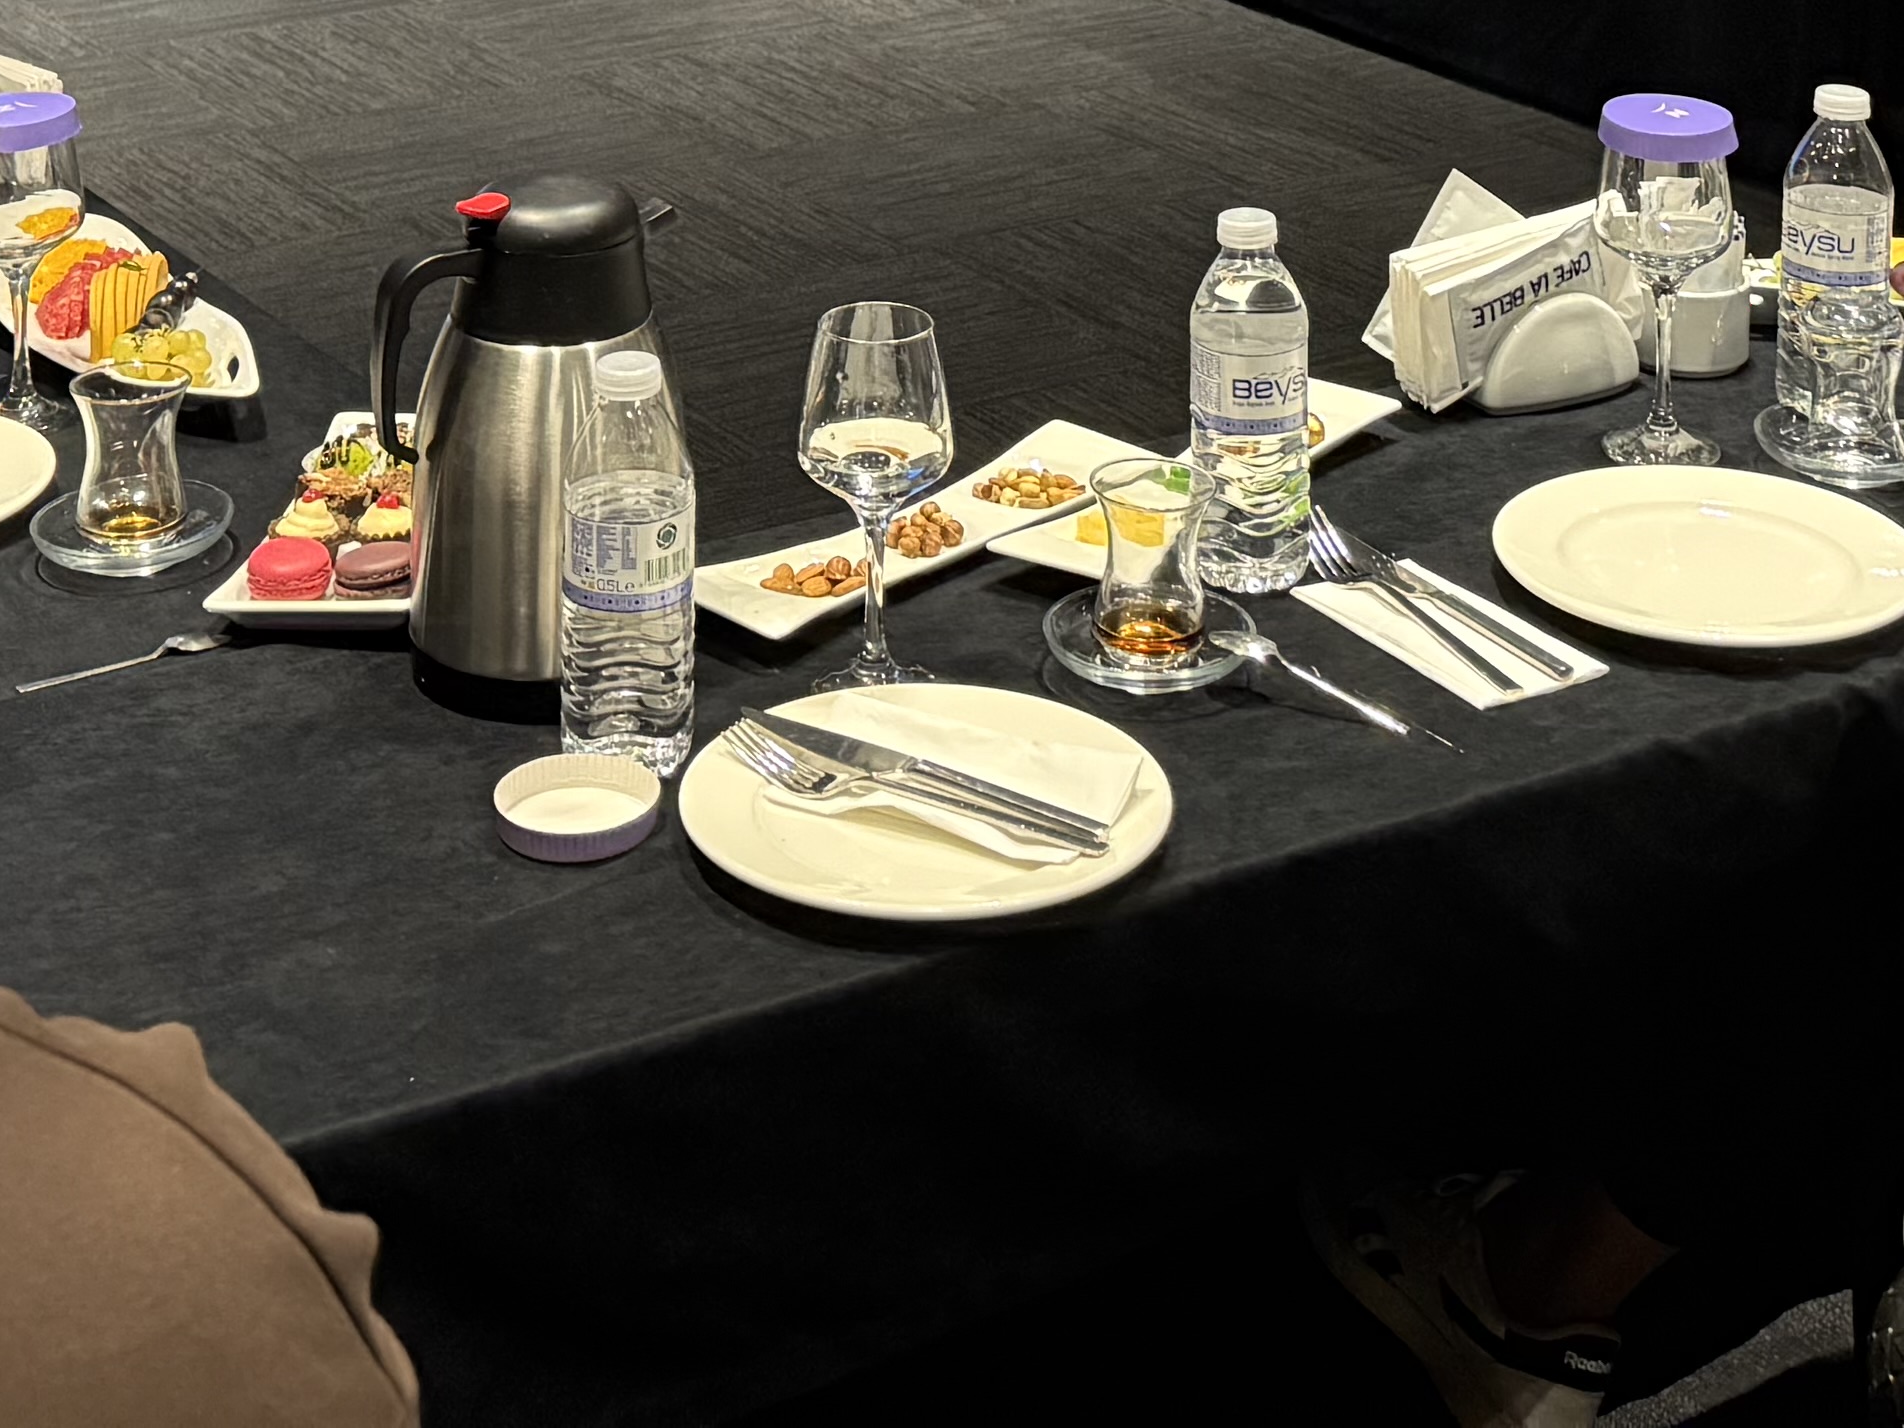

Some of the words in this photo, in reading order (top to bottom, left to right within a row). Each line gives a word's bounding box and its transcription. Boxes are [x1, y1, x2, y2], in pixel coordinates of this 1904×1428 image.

[1783, 224, 1855, 256] eysu
[1529, 272, 1550, 298] LA
[1471, 285, 1525, 329] BELLE
[1232, 372, 1306, 406] Beys
